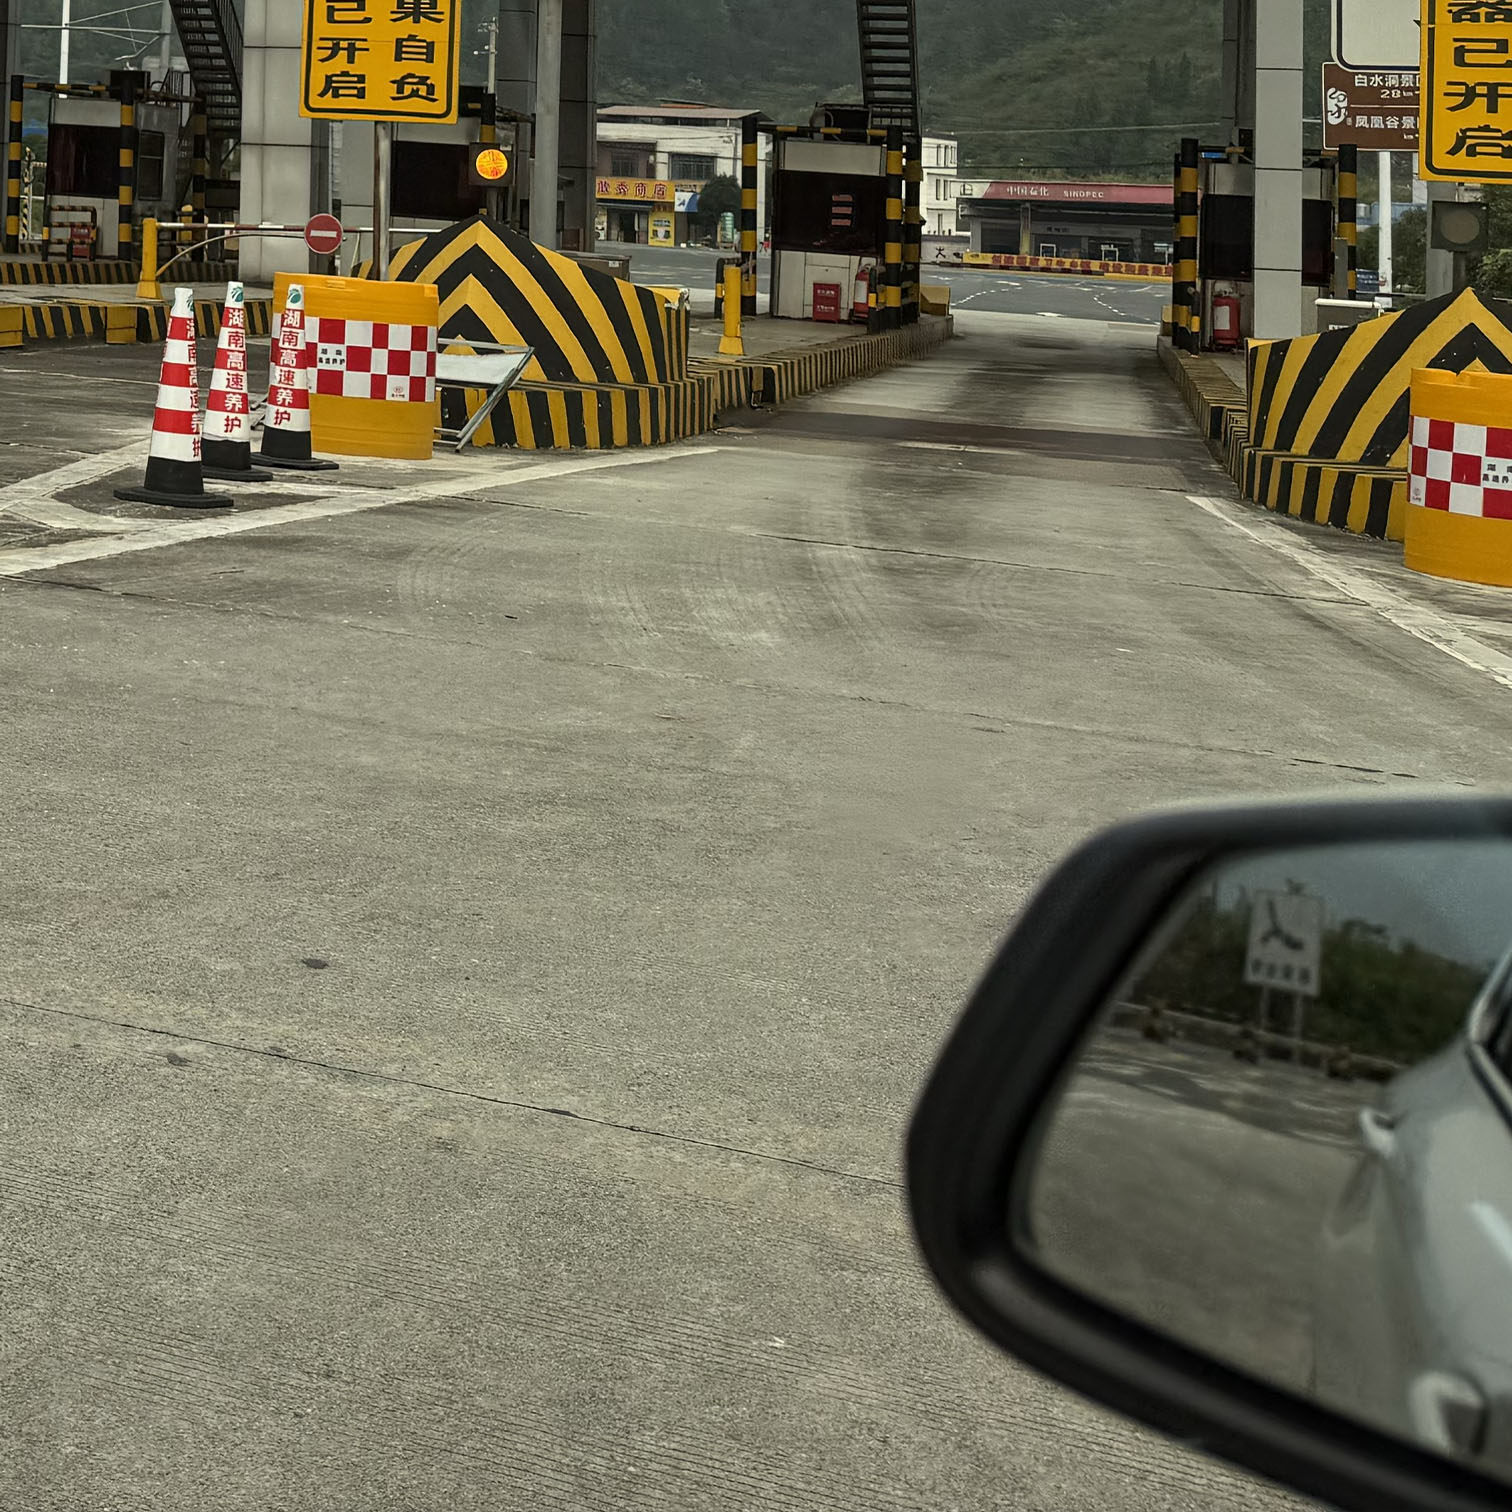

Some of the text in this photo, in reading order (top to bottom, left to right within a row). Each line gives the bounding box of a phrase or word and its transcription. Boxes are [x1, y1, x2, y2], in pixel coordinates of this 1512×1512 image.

[1354, 74, 1420, 88] 白水洞景
[1380, 89, 1401, 99] 28
[1354, 115, 1420, 129] 凤凰谷景
[223, 308, 245, 434] 湖南高速养护
[273, 309, 301, 426] 湖南高速养护
